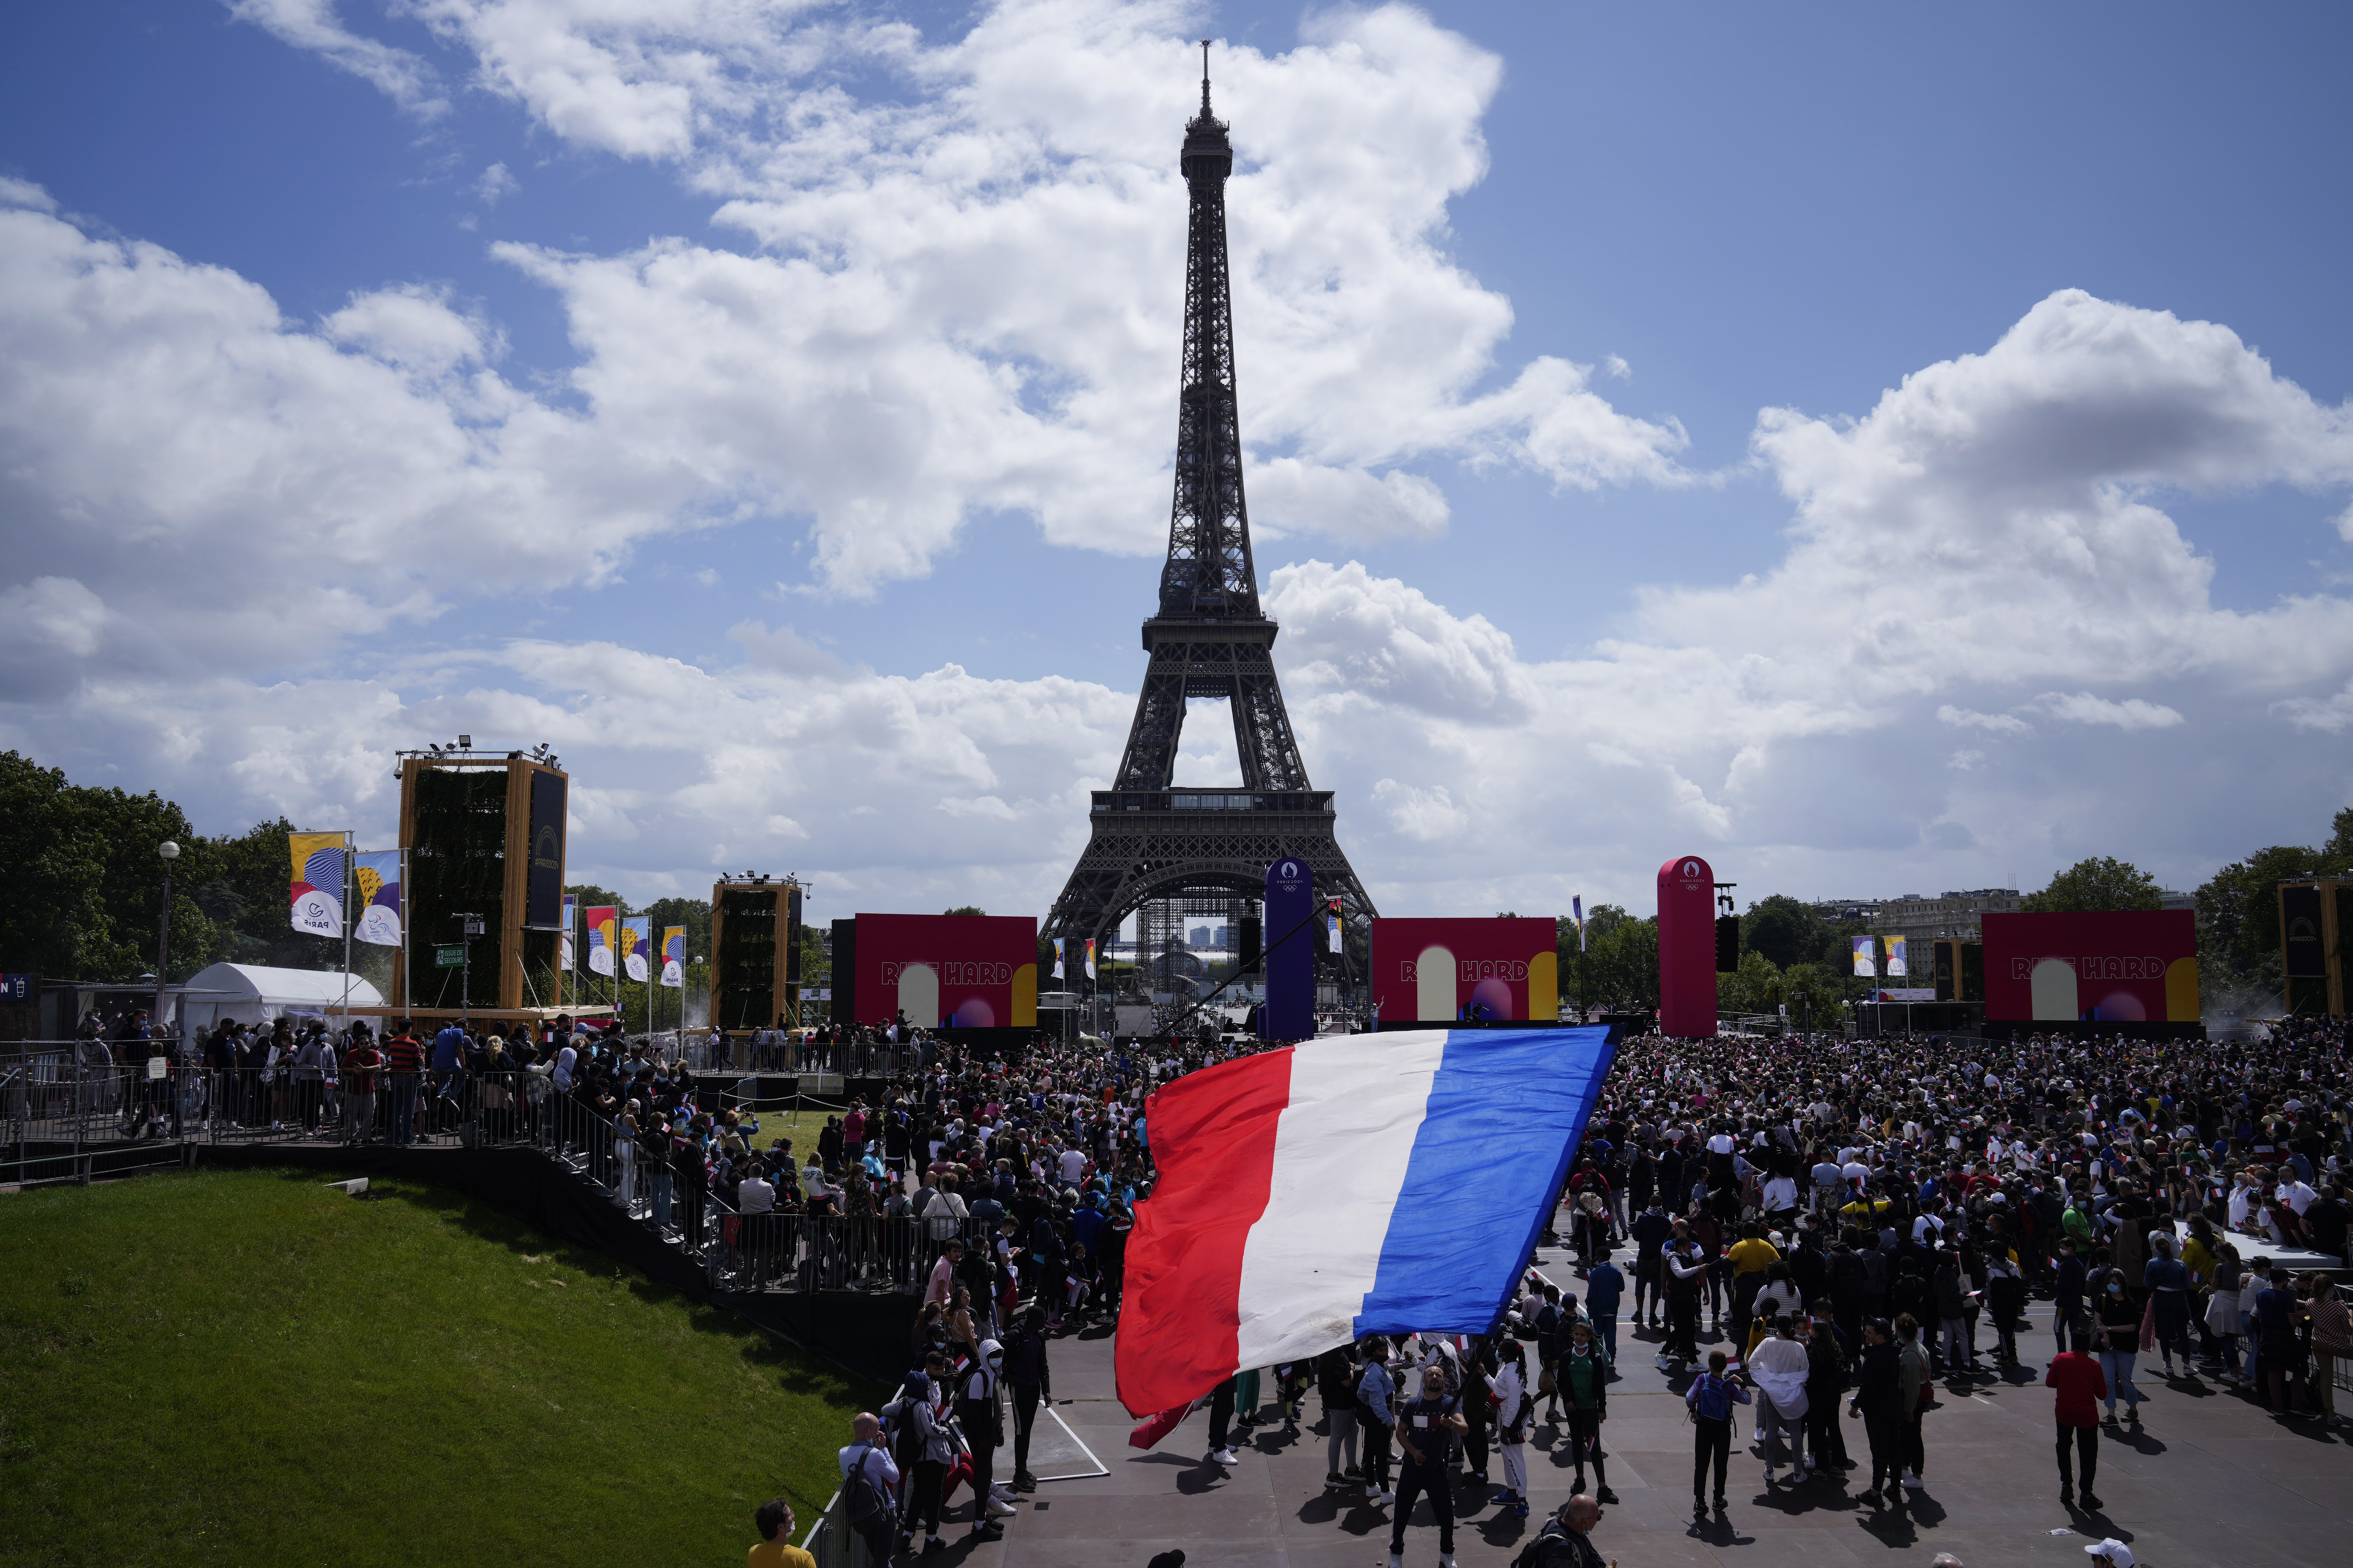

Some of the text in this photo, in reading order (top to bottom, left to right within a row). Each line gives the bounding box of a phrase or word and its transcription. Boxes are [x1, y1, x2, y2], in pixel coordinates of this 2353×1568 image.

[535, 857, 559, 869] #PARIS2024
[945, 962, 1013, 985] HARD
[1462, 960, 1529, 981] HARD
[2083, 957, 2165, 979] HARD
[1032, 1098, 1038, 1108] 07
